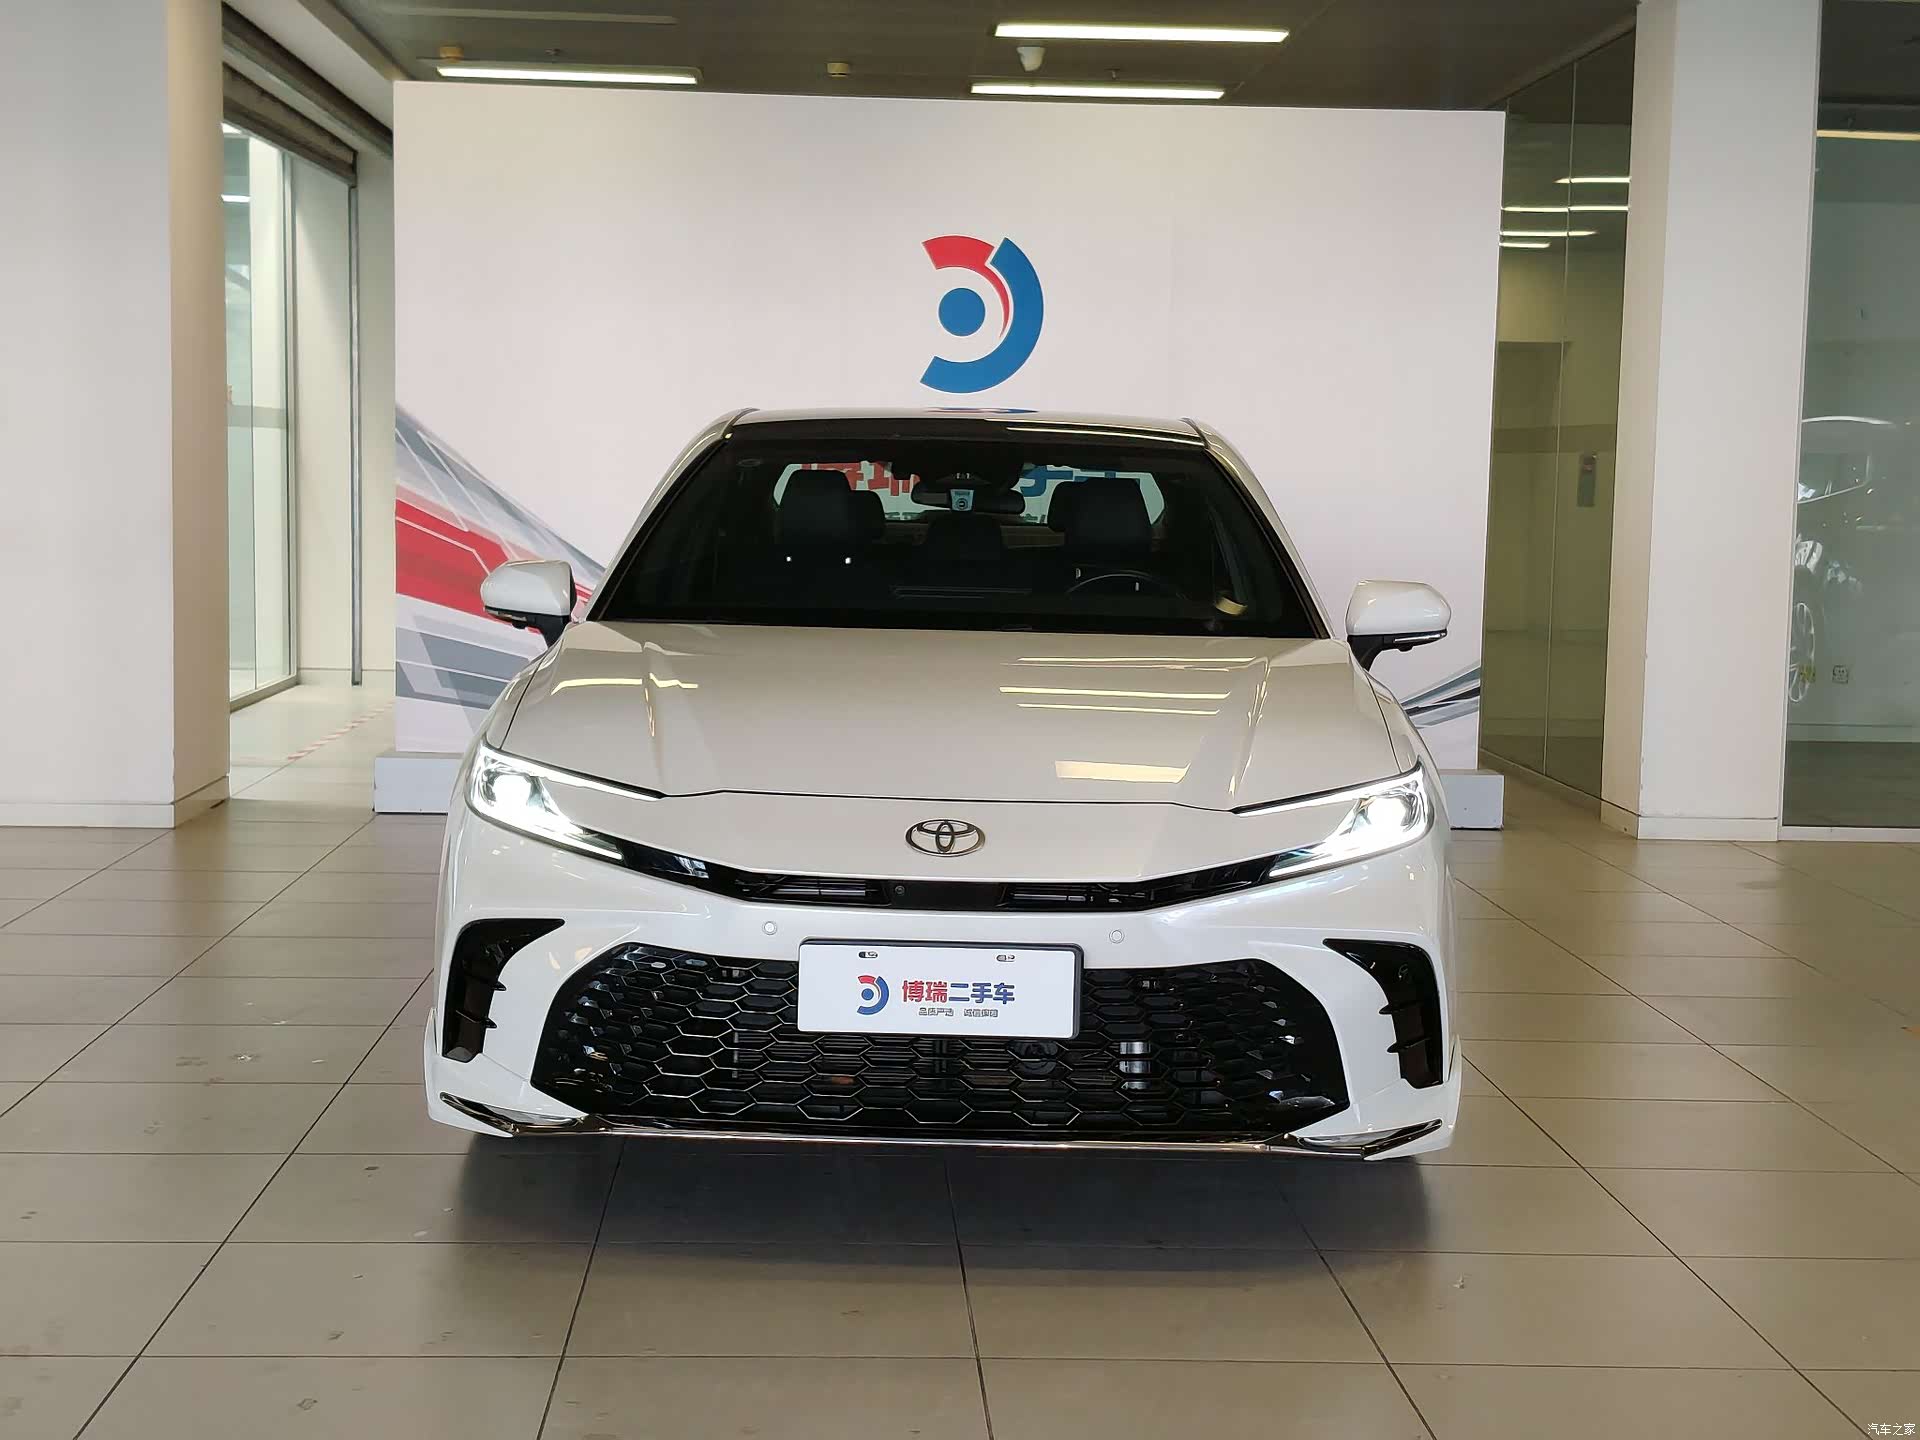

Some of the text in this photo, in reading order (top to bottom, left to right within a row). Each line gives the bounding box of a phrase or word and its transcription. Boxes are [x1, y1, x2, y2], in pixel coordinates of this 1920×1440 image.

[902, 980, 1015, 1005] 博瑞二手车
